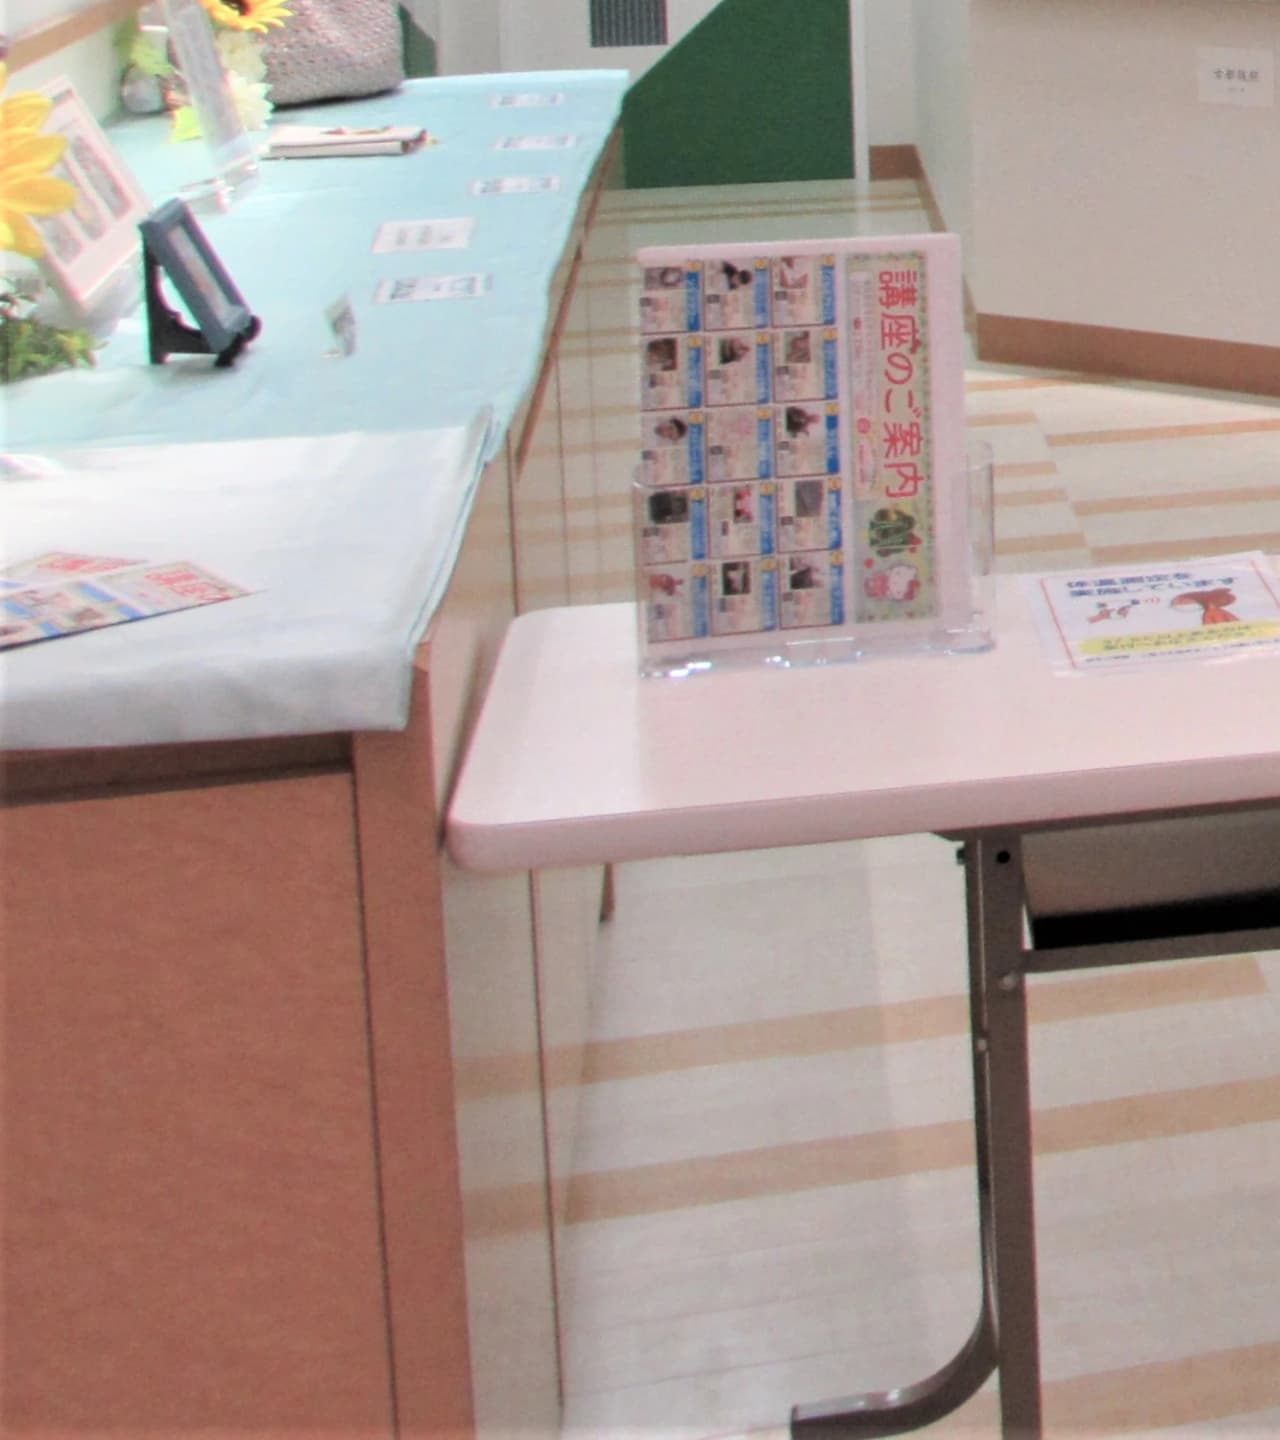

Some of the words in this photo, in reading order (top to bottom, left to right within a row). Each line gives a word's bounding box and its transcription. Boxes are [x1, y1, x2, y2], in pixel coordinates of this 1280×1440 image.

[878, 268, 924, 501] 講座のご案内
